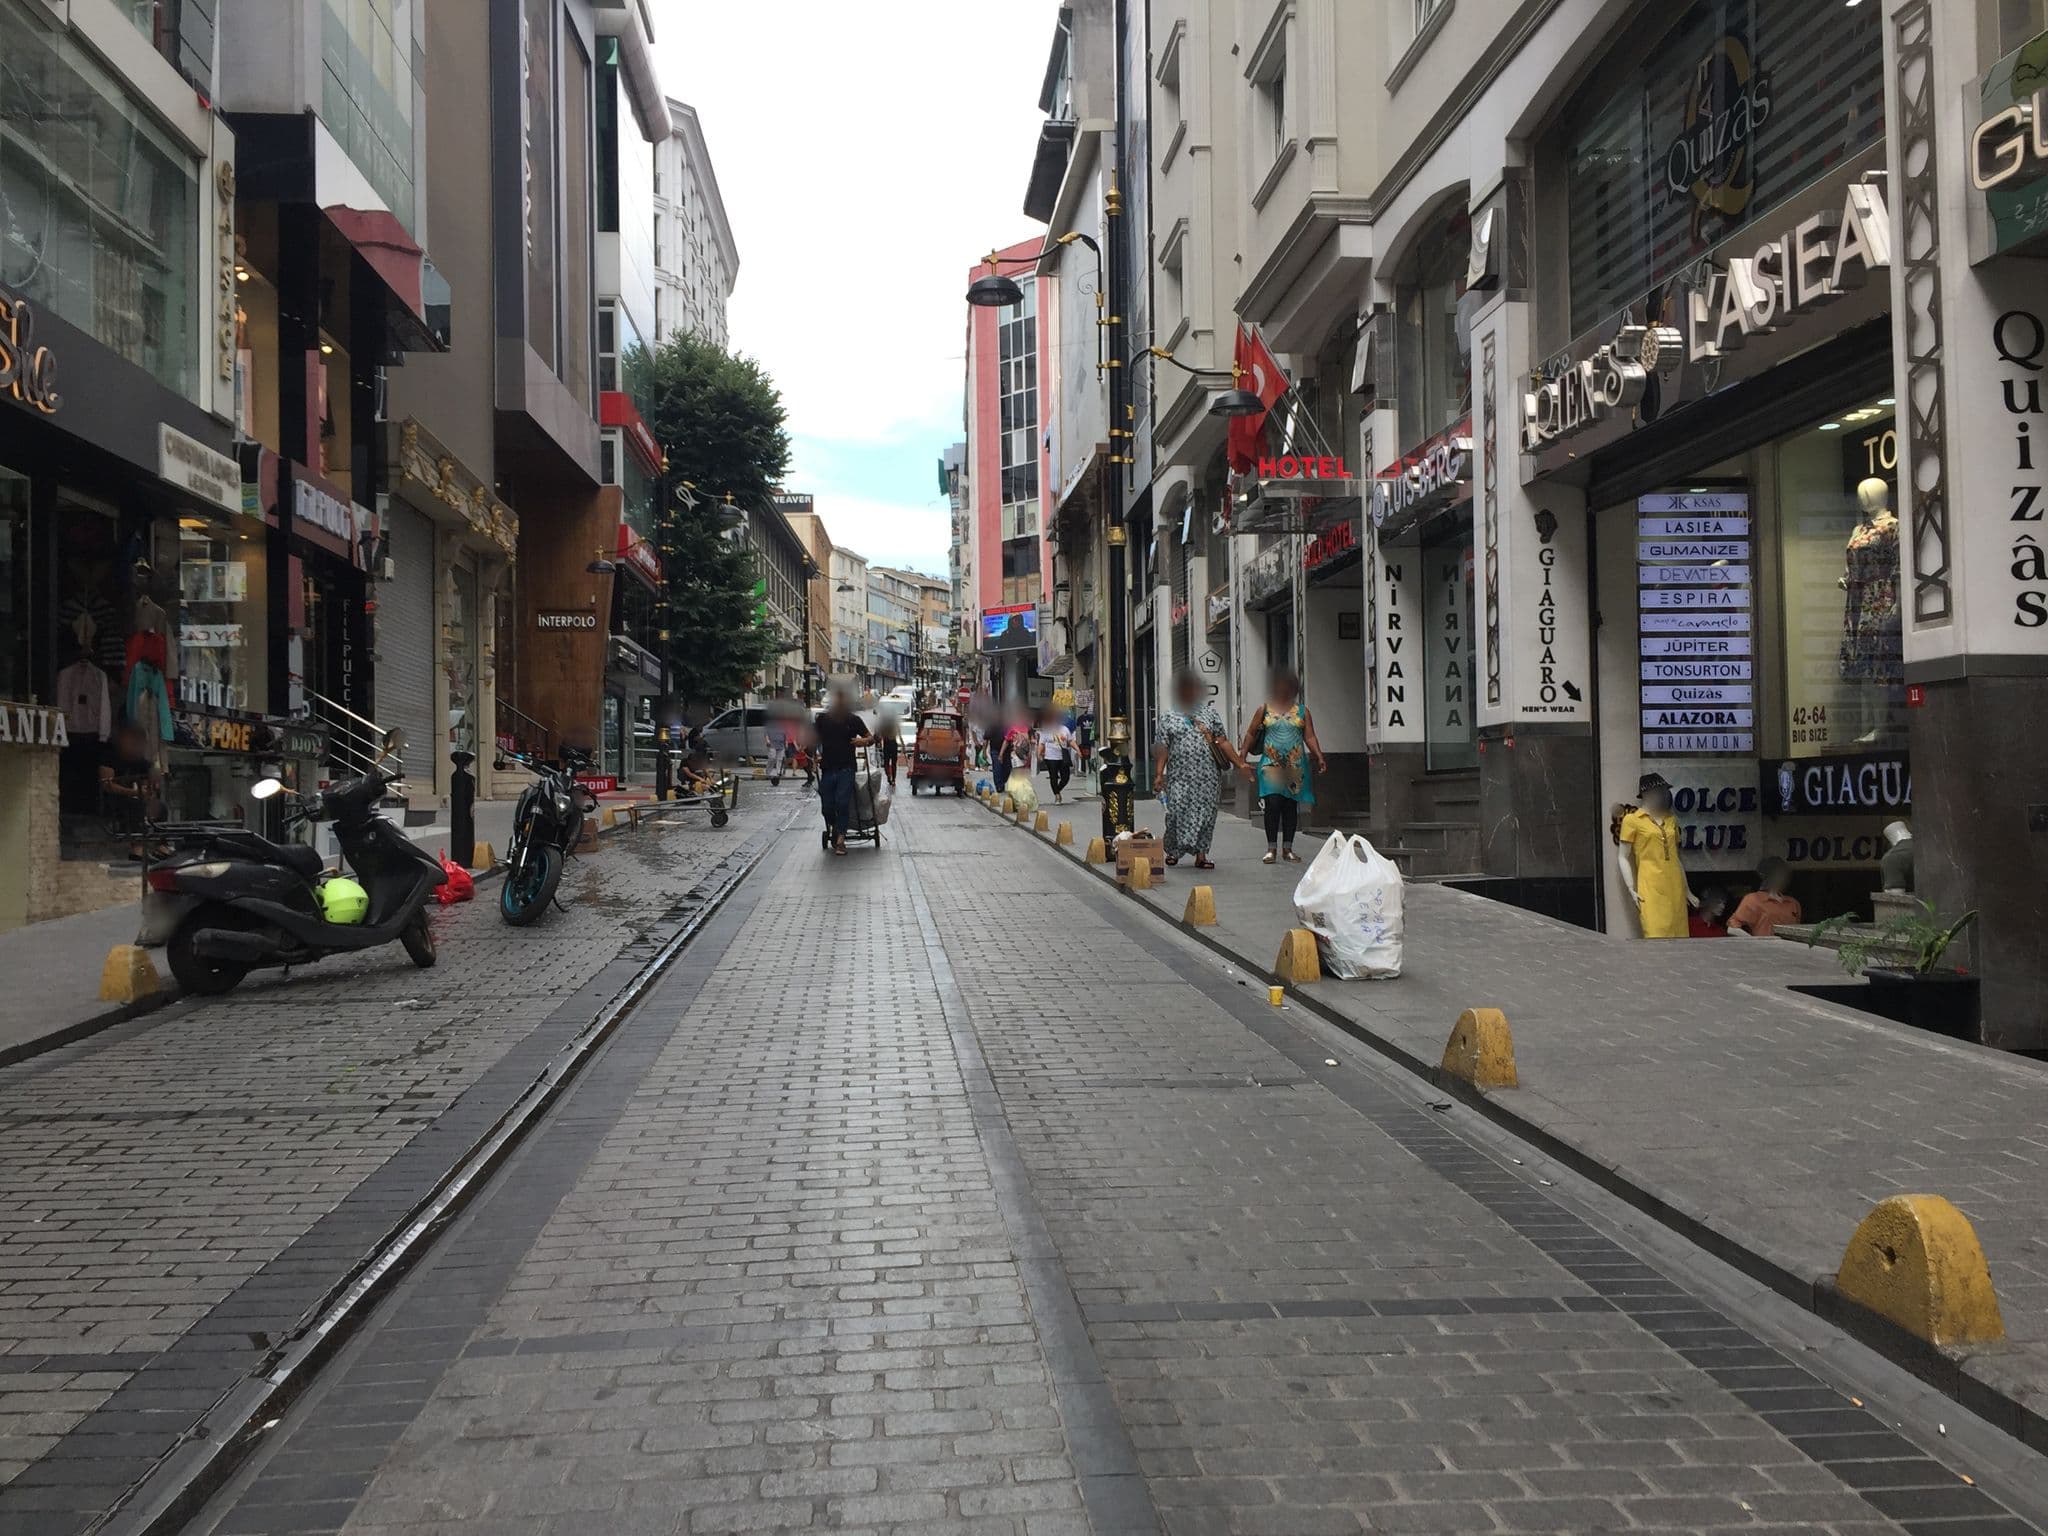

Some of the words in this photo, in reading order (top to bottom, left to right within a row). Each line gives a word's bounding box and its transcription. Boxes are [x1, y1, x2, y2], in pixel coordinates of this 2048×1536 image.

[1258, 456, 1353, 478] HOTEL
[1418, 437, 1461, 498] BERG
[1665, 521, 1723, 533] LASIEA
[1660, 568, 1731, 581] DEVATEX
[1660, 592, 1732, 605] ESPIRA
[1538, 548, 1557, 703] GIAGUARO
[1654, 664, 1741, 677] TONSURTON
[1549, 705, 1575, 713] WEAR
[1792, 706, 1827, 724] 42-64
[1658, 711, 1738, 725] ALAZORA
[1657, 735, 1740, 750] GRIXMOON
[1792, 729, 1807, 743] BIG
[1809, 727, 1828, 742] SIZE
[1679, 824, 1747, 849] LUE
